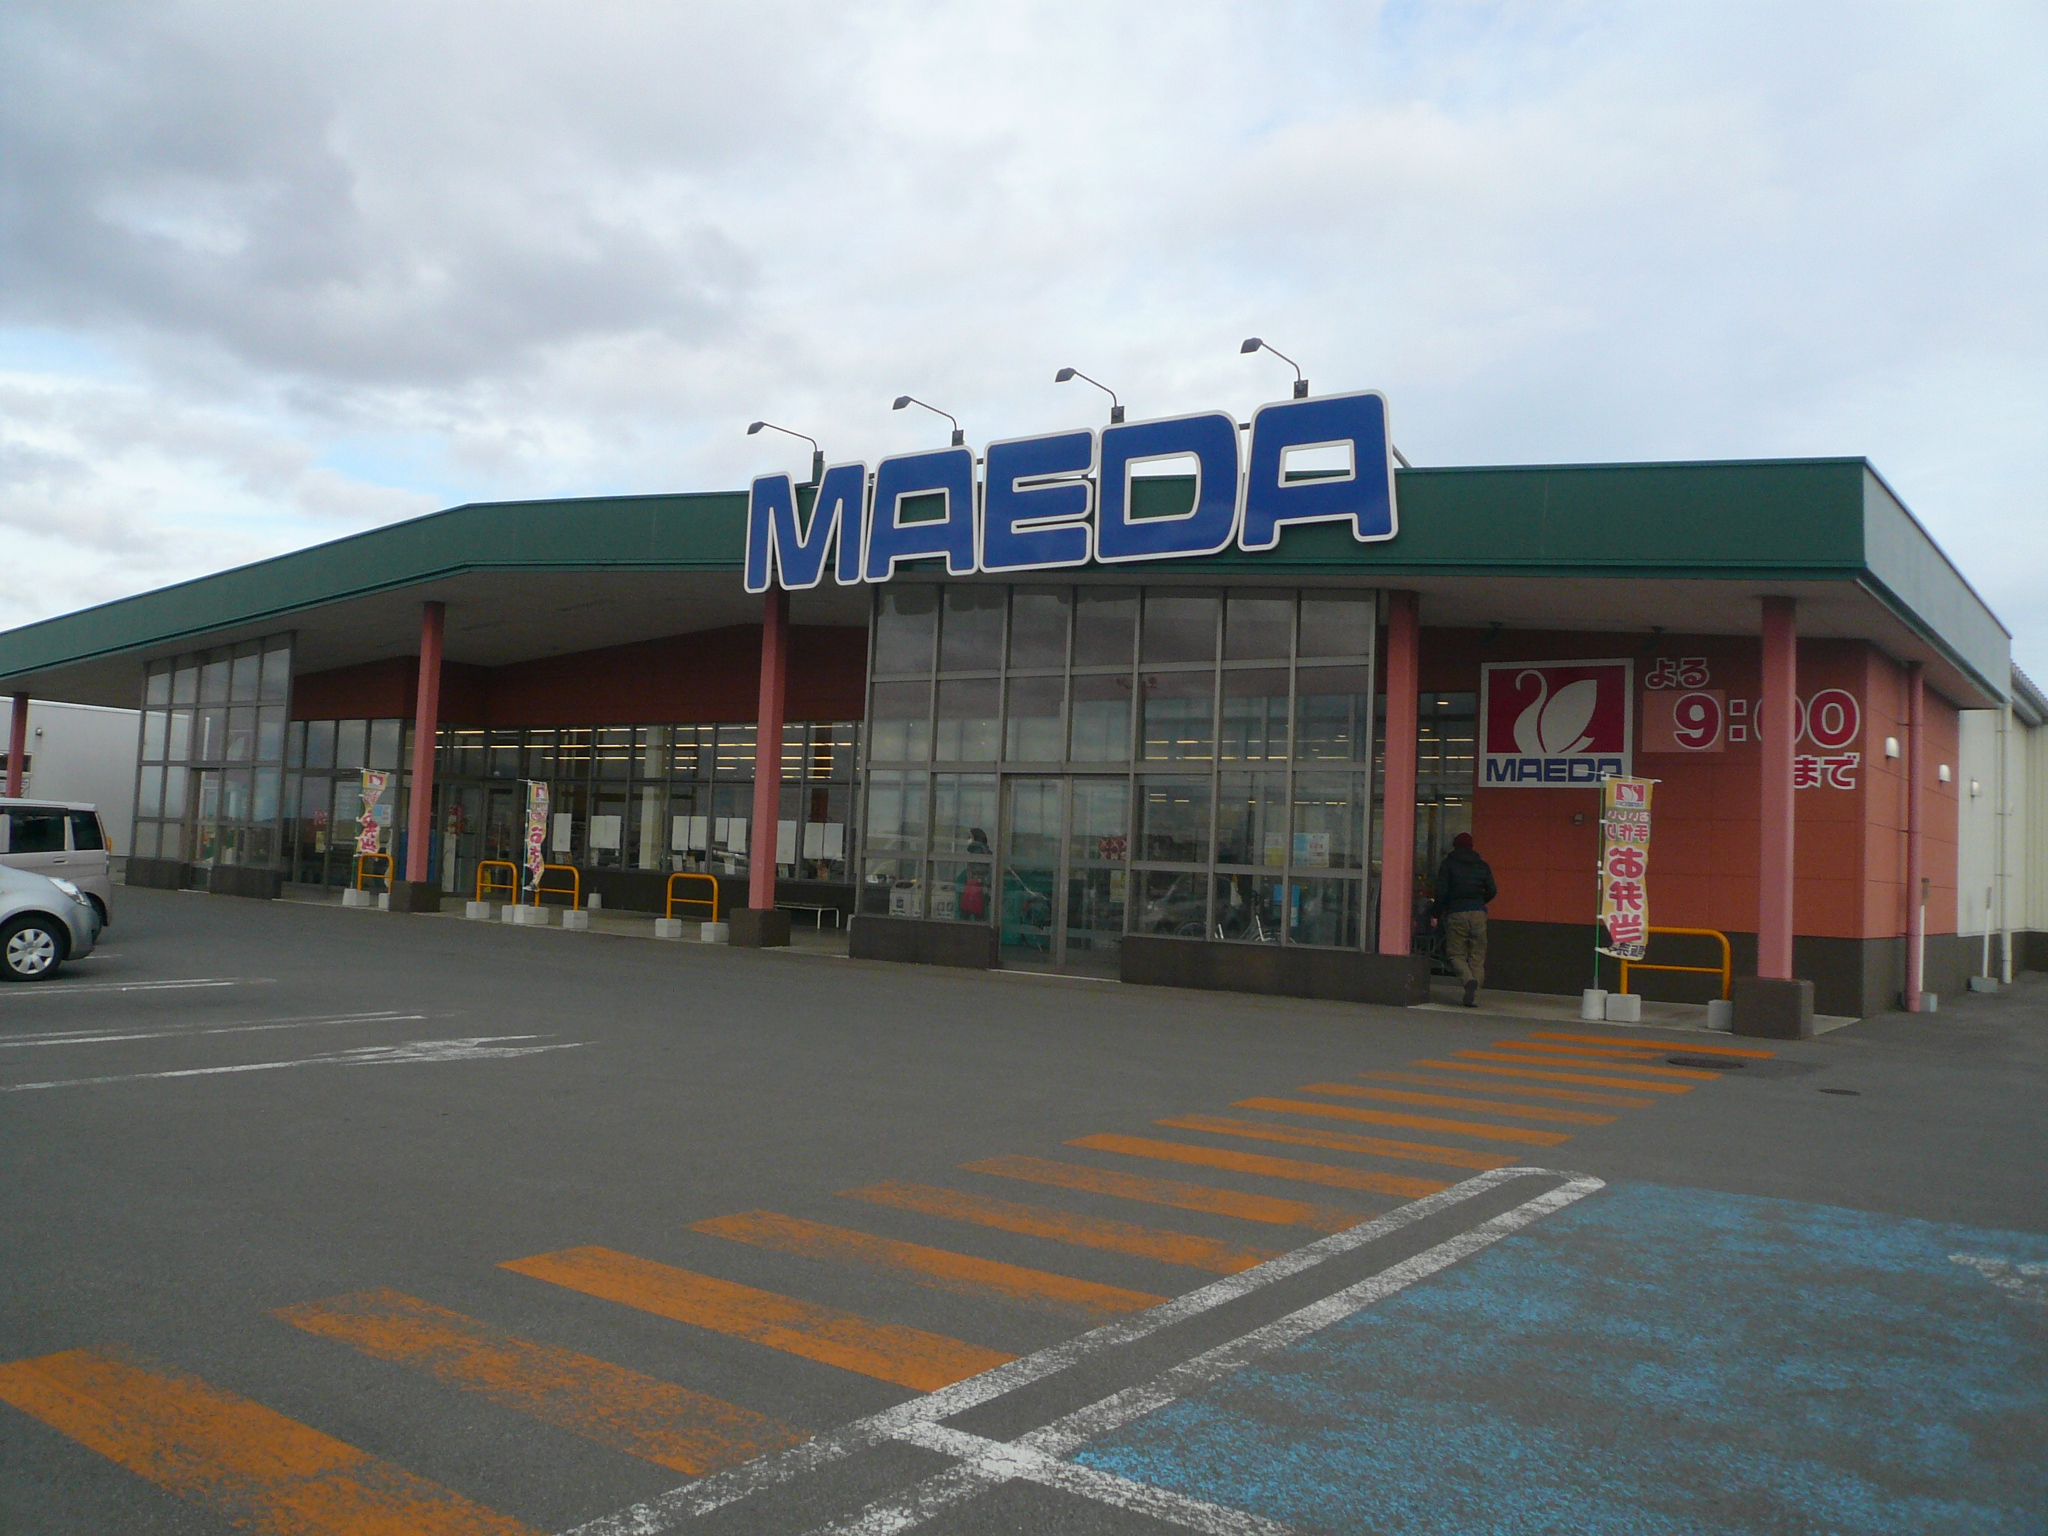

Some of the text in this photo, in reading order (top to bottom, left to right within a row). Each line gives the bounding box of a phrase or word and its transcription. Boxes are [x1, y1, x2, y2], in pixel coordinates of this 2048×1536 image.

[744, 390, 1399, 593] MAEDA
[1645, 657, 1710, 689] よる
[1486, 758, 1622, 782] MAEDA
[1794, 752, 1860, 790] まで
